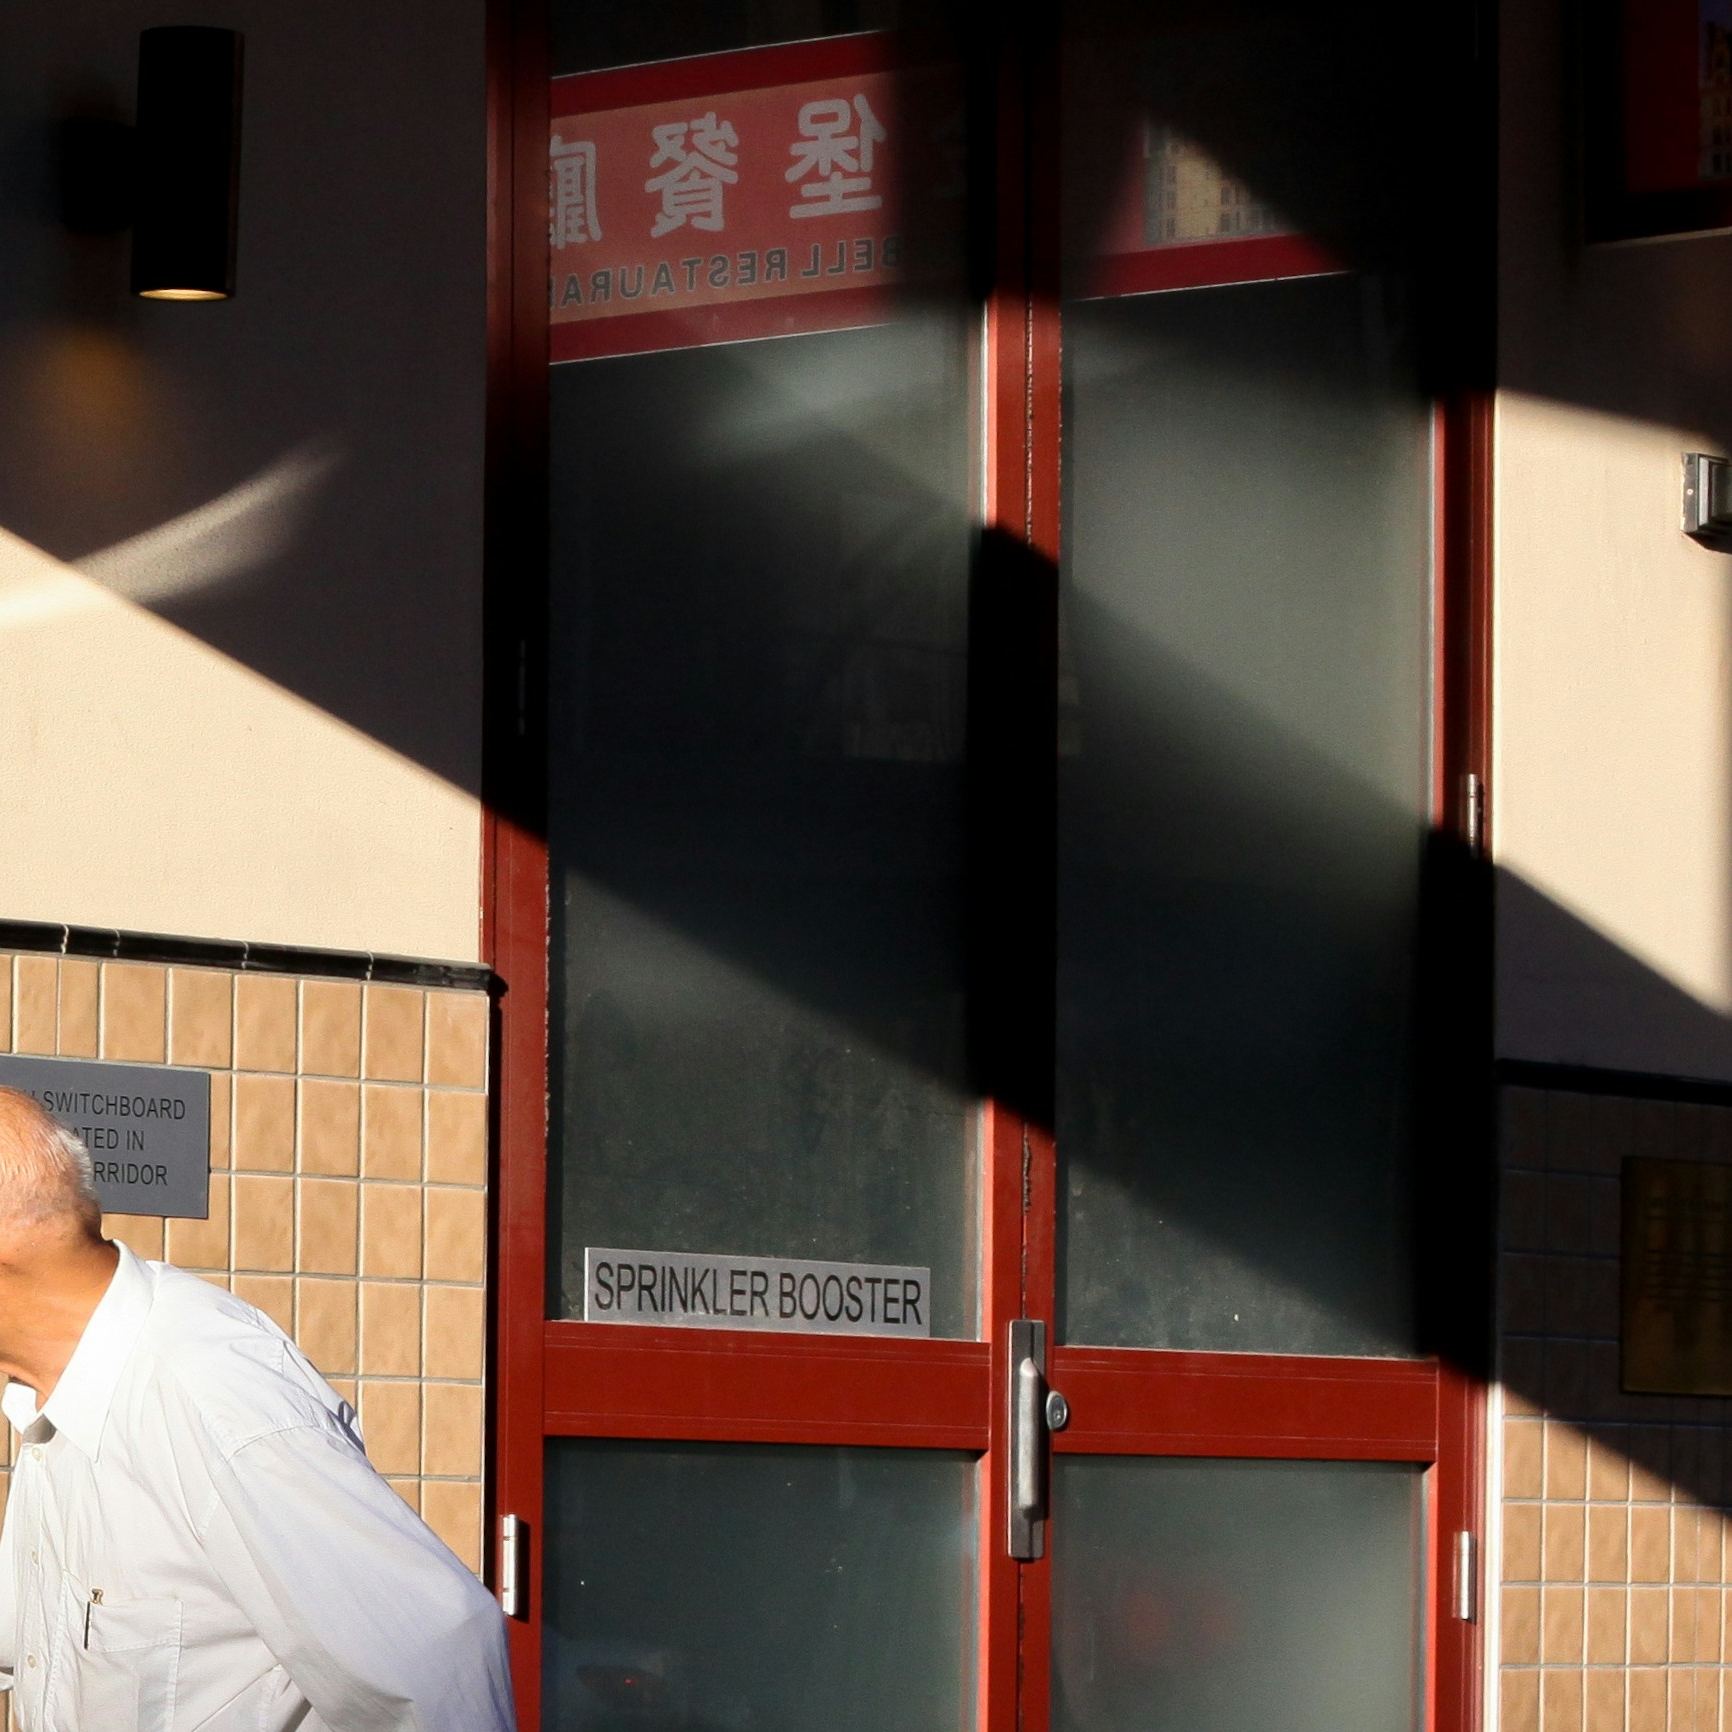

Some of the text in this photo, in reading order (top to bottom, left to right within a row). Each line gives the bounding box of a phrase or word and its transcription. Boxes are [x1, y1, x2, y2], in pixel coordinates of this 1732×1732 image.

[42, 1090, 186, 1121] SWITCHBOARD
[126, 1129, 145, 1151] IN
[93, 1161, 168, 1187] RRIDOR
[594, 1261, 923, 1326] SPRINKLER BOOSTER
